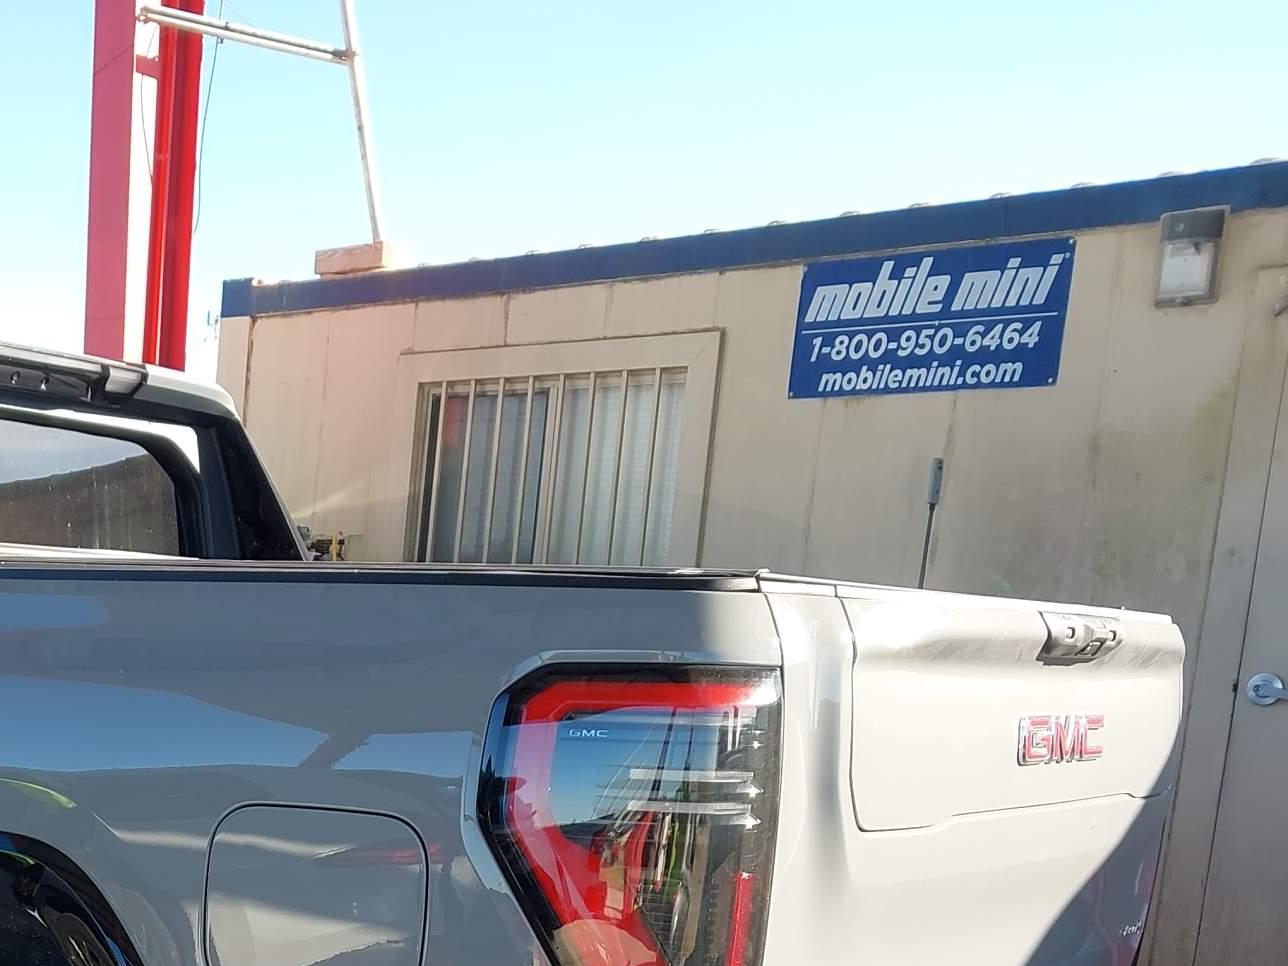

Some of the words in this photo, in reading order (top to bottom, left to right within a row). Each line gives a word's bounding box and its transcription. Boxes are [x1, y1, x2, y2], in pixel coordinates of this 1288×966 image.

[804, 256, 951, 322] mobile
[950, 253, 1064, 311] mini
[810, 320, 1042, 362] 1-800-950-6464
[818, 359, 1023, 392] mobilemini.com
[569, 729, 609, 738] GMC
[1017, 714, 1104, 766] GMC
